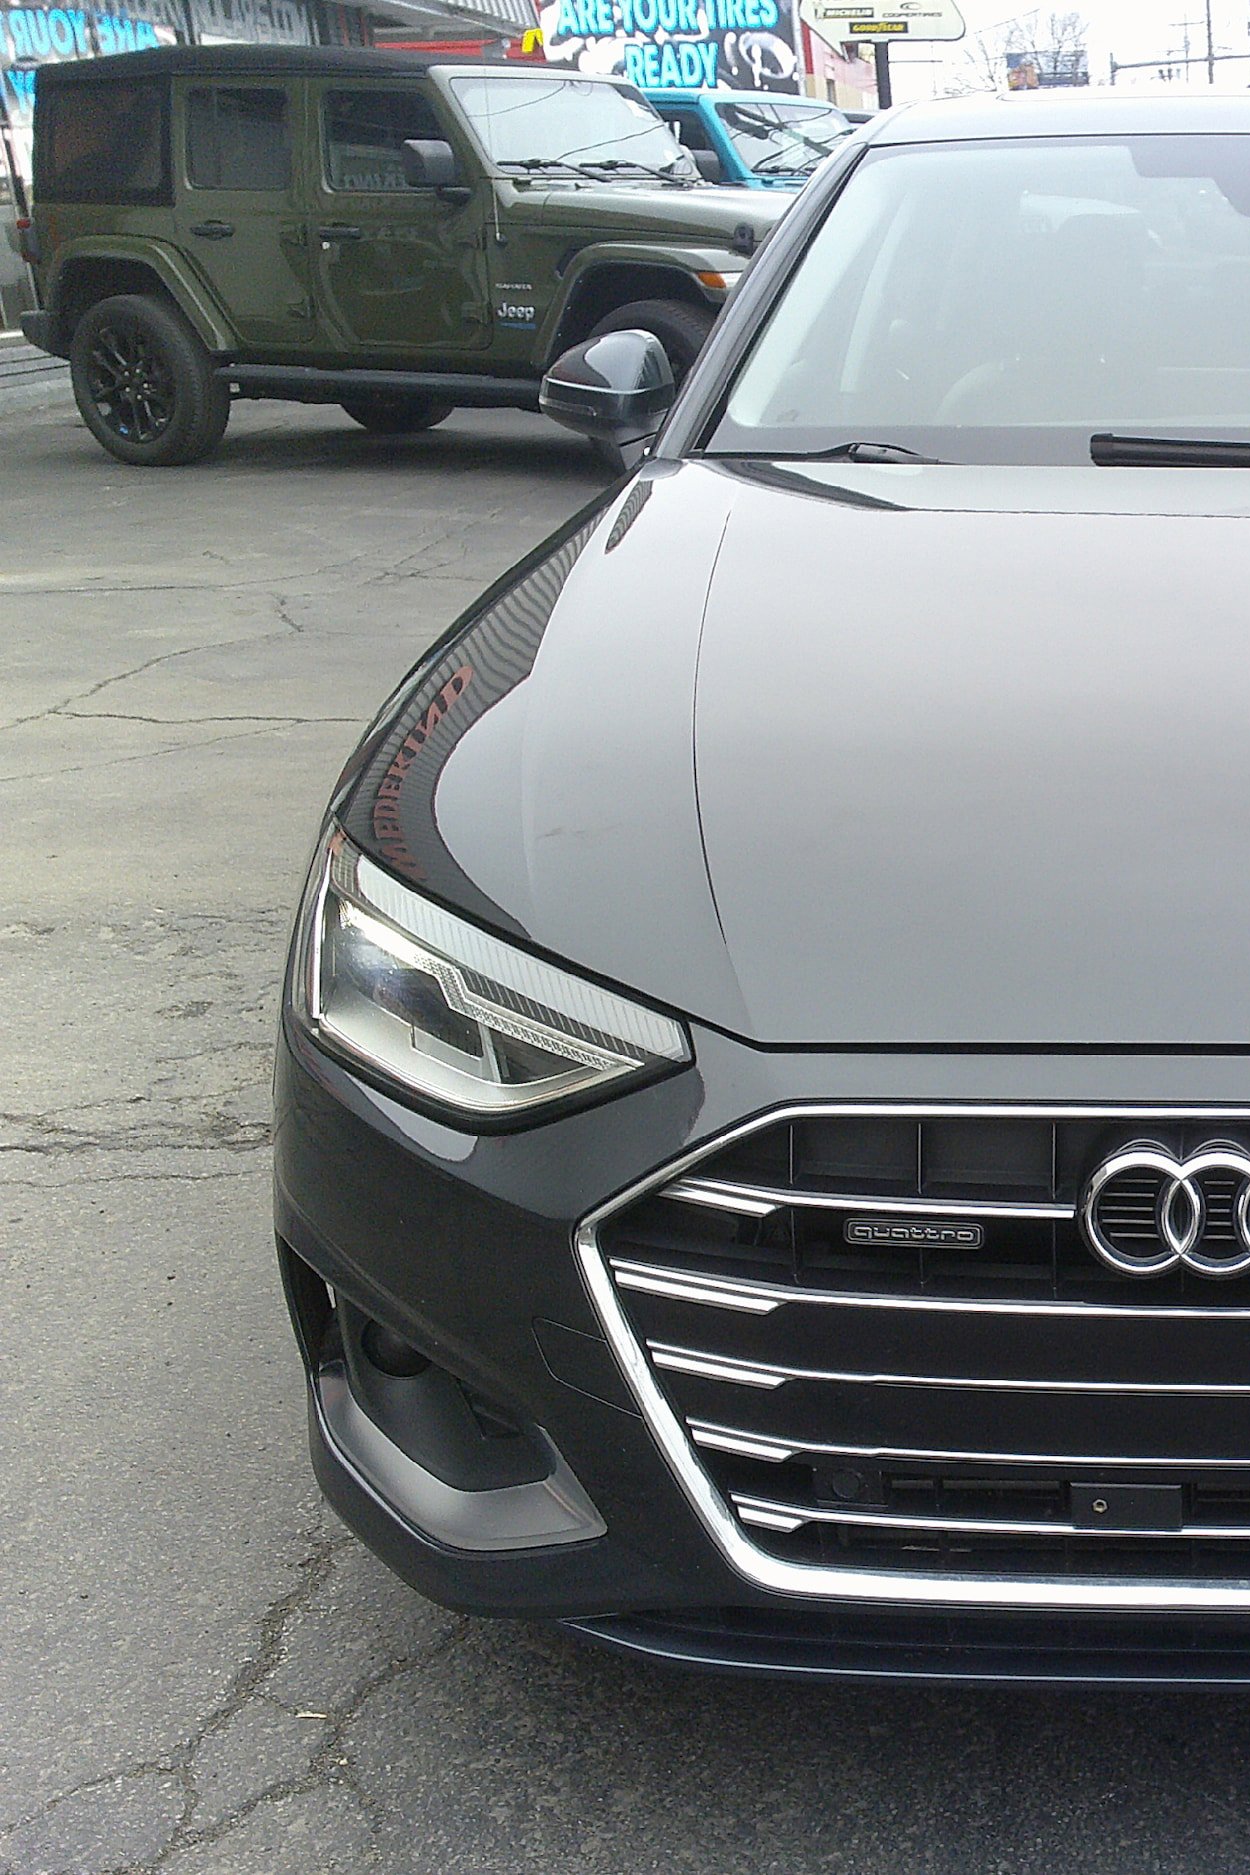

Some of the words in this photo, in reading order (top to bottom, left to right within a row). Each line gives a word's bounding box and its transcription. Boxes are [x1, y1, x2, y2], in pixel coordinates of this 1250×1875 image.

[557, 0, 614, 36] ARE
[620, 0, 700, 33] YOUR
[702, 0, 779, 30] TIRES
[625, 42, 719, 88] READY
[497, 302, 535, 321] Jeep
[853, 1226, 974, 1242] quattro
